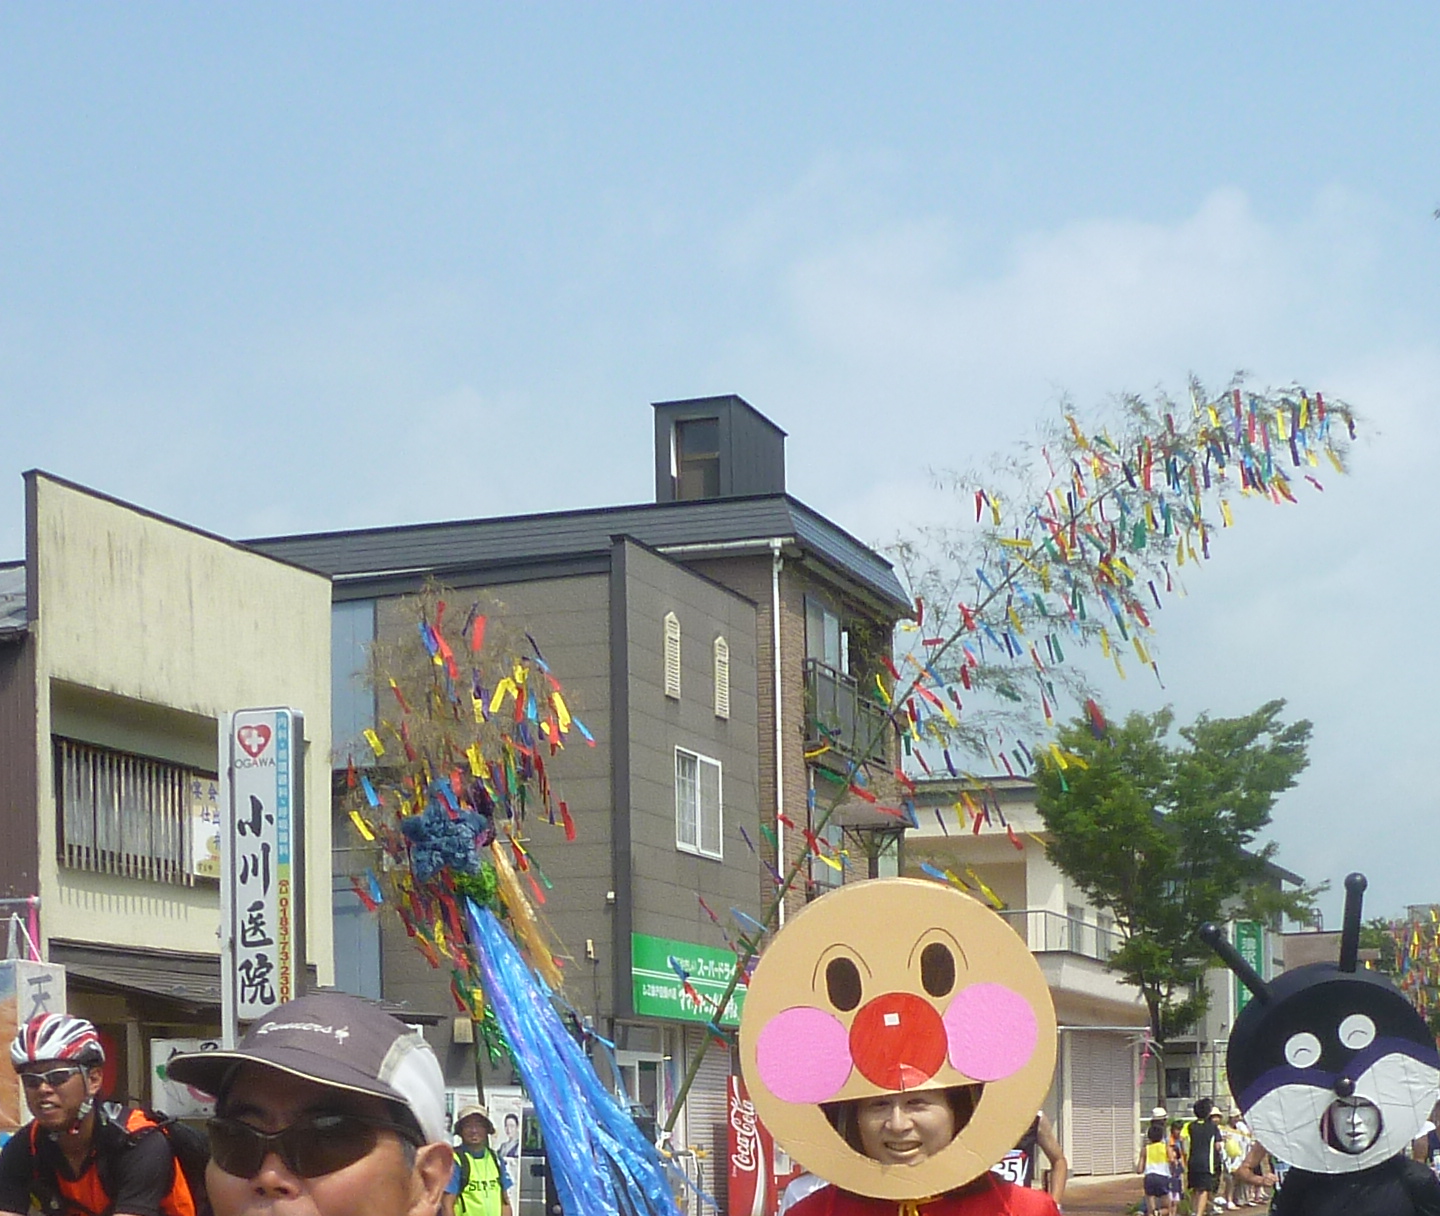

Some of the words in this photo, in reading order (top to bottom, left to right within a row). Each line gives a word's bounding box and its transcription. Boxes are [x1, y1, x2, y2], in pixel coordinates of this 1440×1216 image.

[234, 758, 276, 769] OGAWA
[237, 794, 277, 1006] 小川医院
[278, 897, 290, 1003] 0183-73-2300
